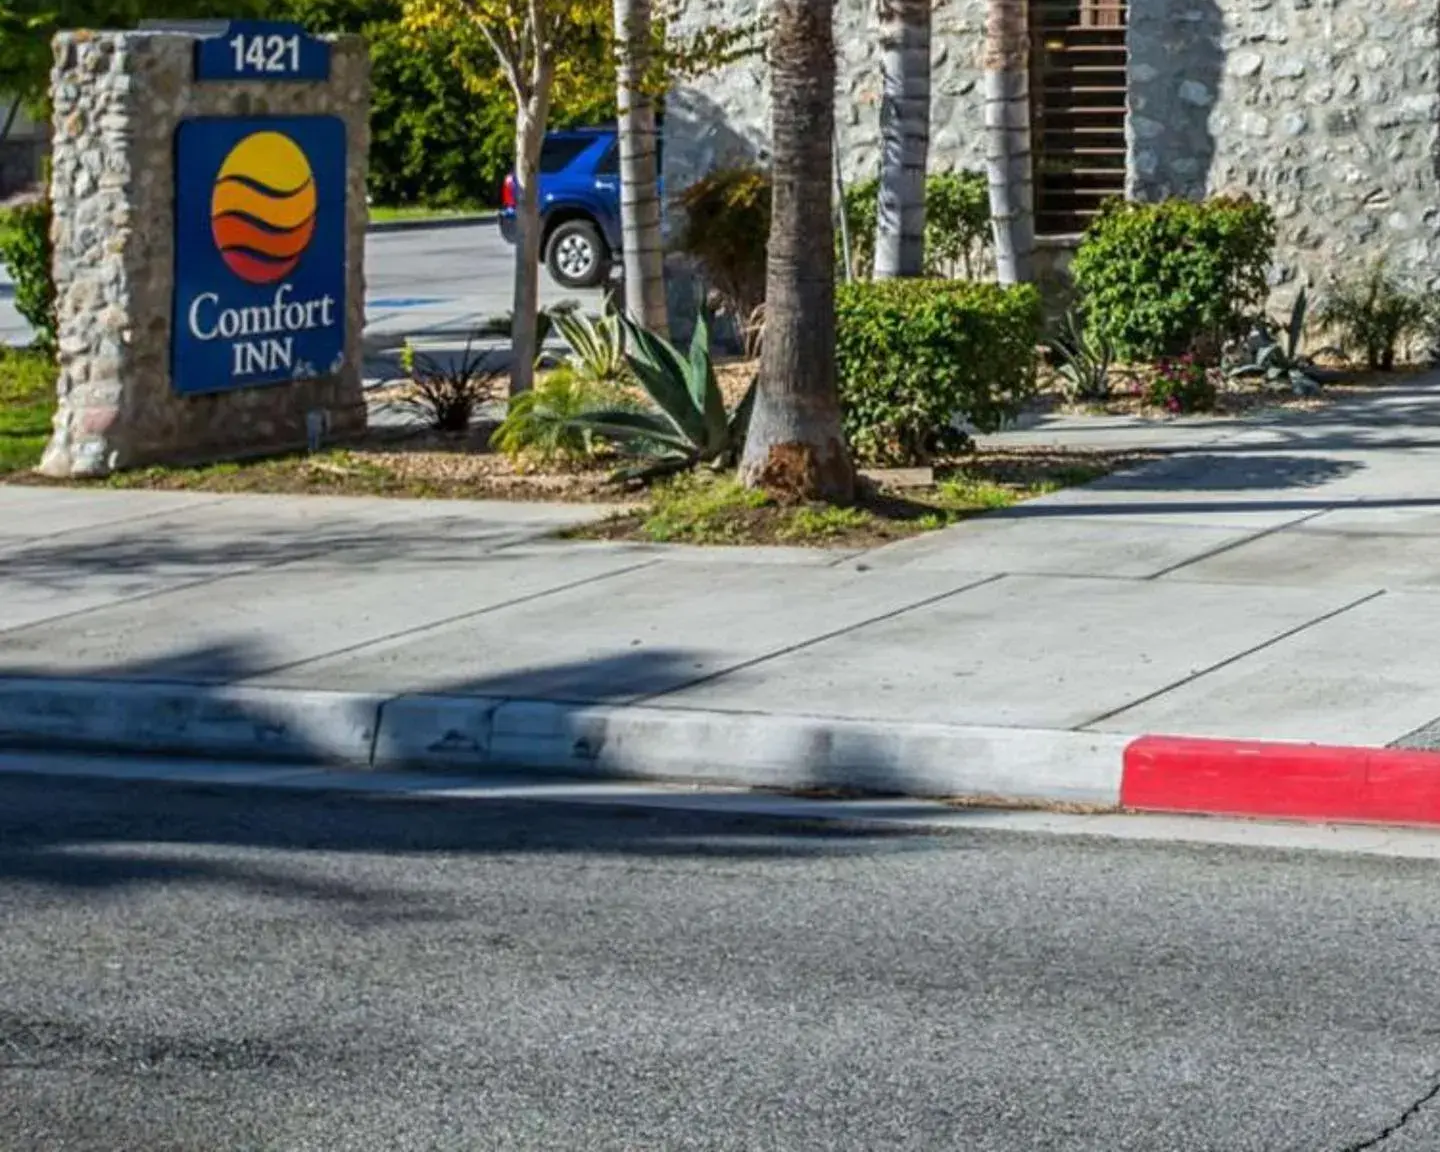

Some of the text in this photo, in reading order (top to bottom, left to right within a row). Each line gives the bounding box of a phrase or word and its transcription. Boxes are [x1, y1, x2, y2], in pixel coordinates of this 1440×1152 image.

[229, 33, 300, 72] 1421
[188, 283, 335, 341] Comfort
[231, 336, 294, 376] INN
